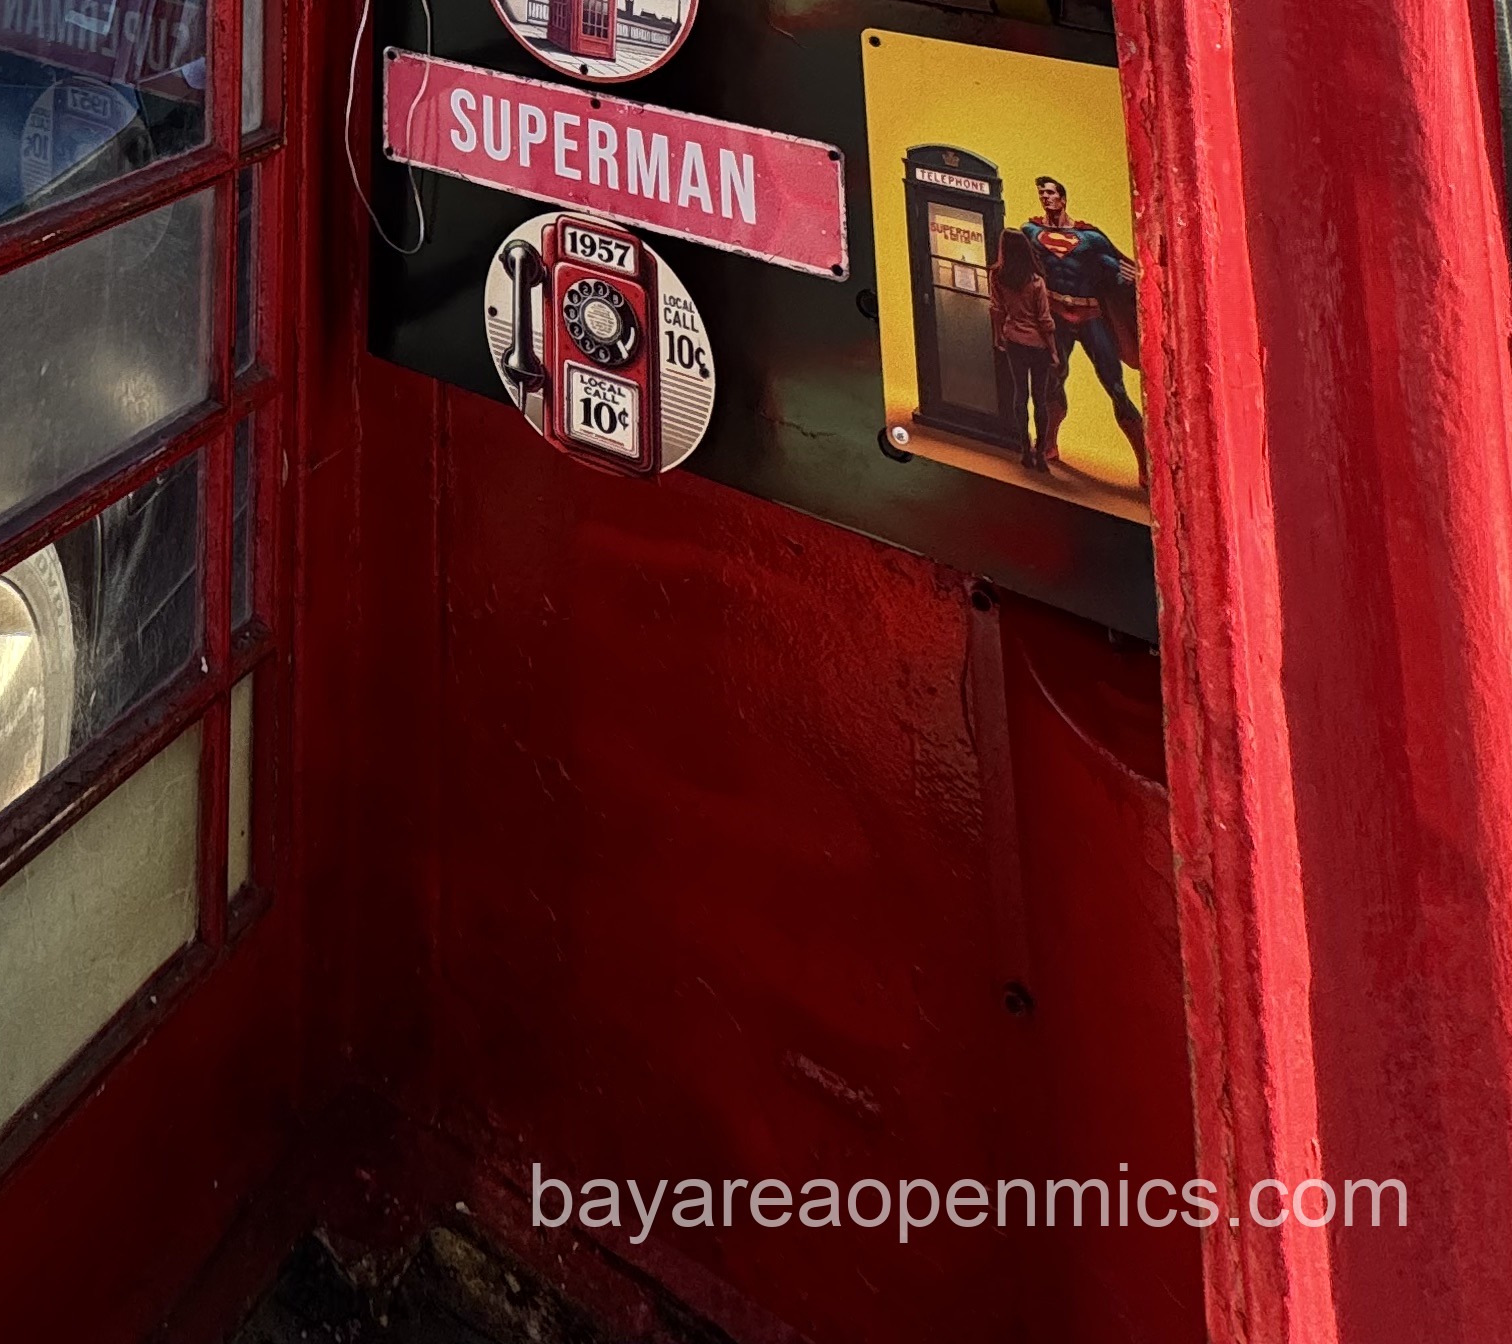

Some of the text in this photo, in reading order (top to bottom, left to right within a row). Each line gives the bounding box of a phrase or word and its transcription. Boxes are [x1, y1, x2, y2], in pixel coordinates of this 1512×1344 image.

[449, 88, 758, 225] SUPERMAN
[919, 169, 986, 192] TELEPHONE
[568, 230, 631, 268] 1957
[663, 293, 695, 313] LOCAL
[663, 308, 699, 333] CALL
[579, 374, 626, 398] LOCAL
[583, 386, 620, 405] CALL
[579, 398, 630, 435] 10¢
